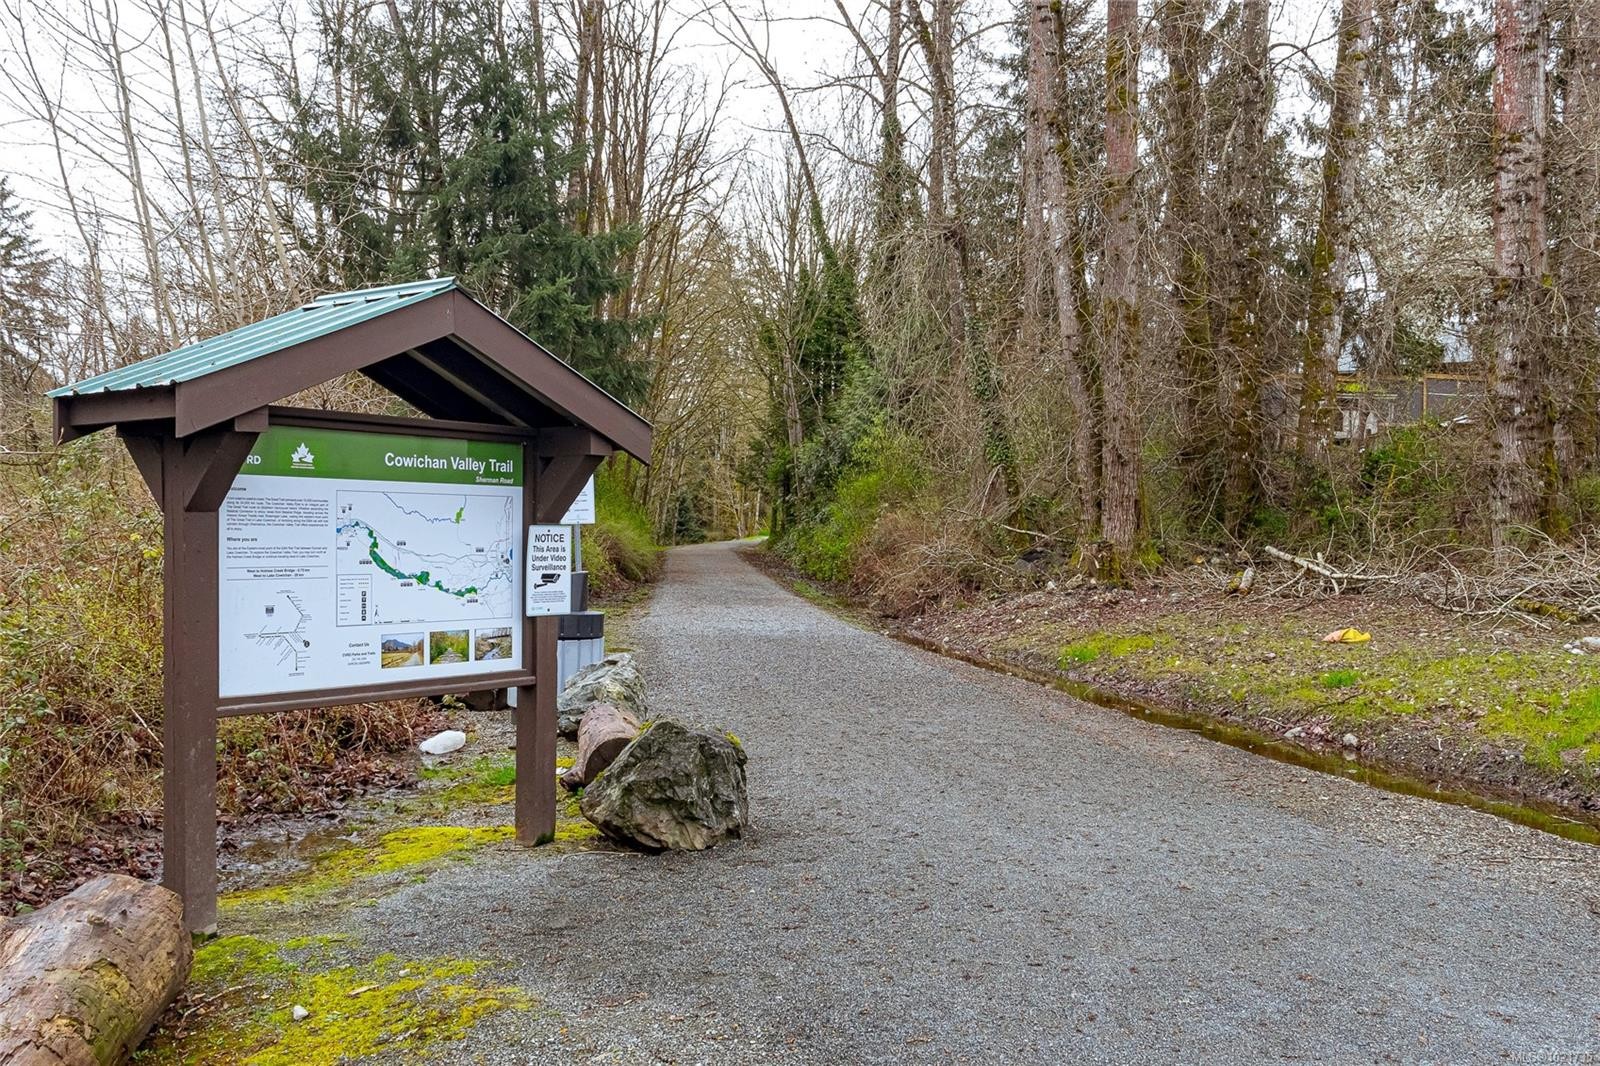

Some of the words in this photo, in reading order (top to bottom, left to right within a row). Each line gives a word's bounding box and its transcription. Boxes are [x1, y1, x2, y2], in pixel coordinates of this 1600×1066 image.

[384, 452, 448, 469] Cowichan
[450, 456, 486, 474] Valley
[489, 458, 513, 473] Trail
[534, 533, 565, 543] NOTICE
[533, 545, 544, 553] This
[545, 545, 560, 553] Area
[561, 545, 566, 553] is
[531, 554, 549, 562] Under
[550, 554, 567, 562] Video
[531, 563, 567, 572] Surveillance
